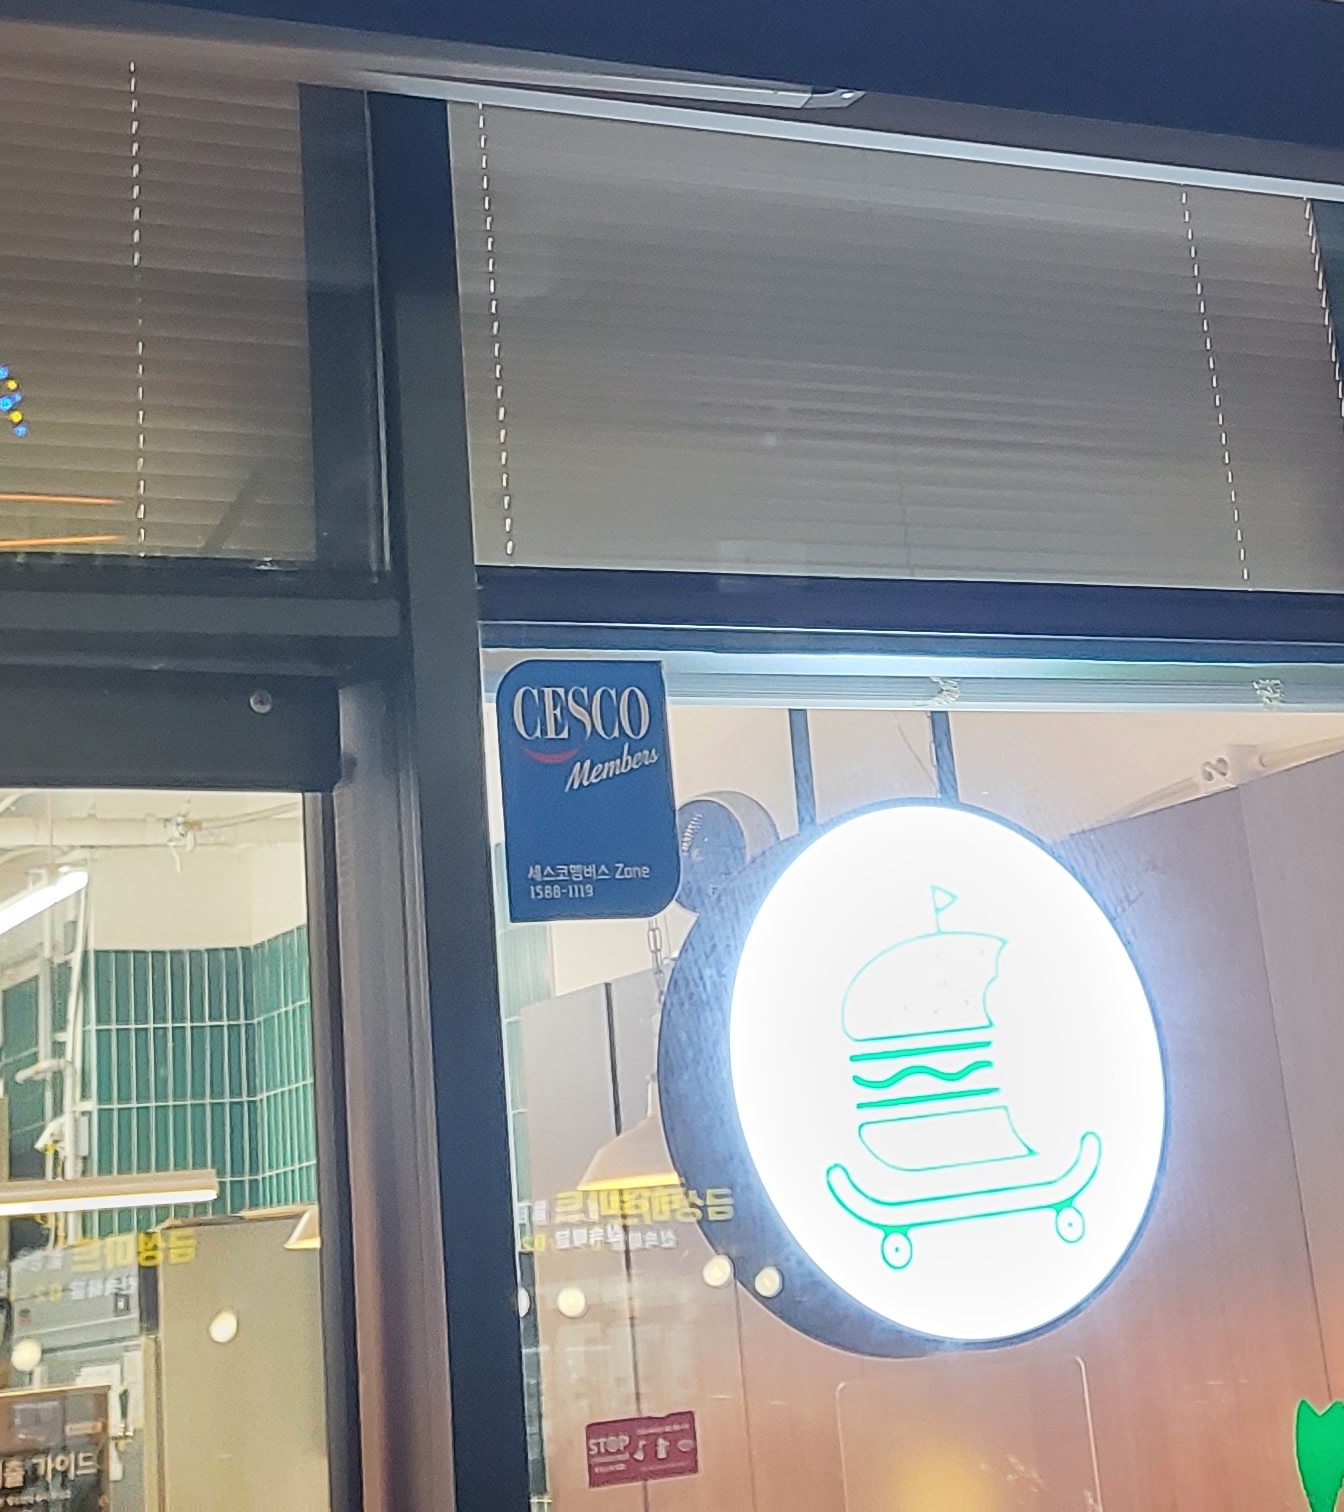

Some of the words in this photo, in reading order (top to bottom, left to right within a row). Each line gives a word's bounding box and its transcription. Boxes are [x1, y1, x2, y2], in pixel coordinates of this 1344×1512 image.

[513, 686, 651, 740] CESCO
[565, 742, 659, 792] Members
[527, 863, 611, 882] 세스코멤버스
[614, 862, 651, 879] Zone
[529, 883, 594, 900] 1588-1119
[33, 1451, 98, 1483] 가이드
